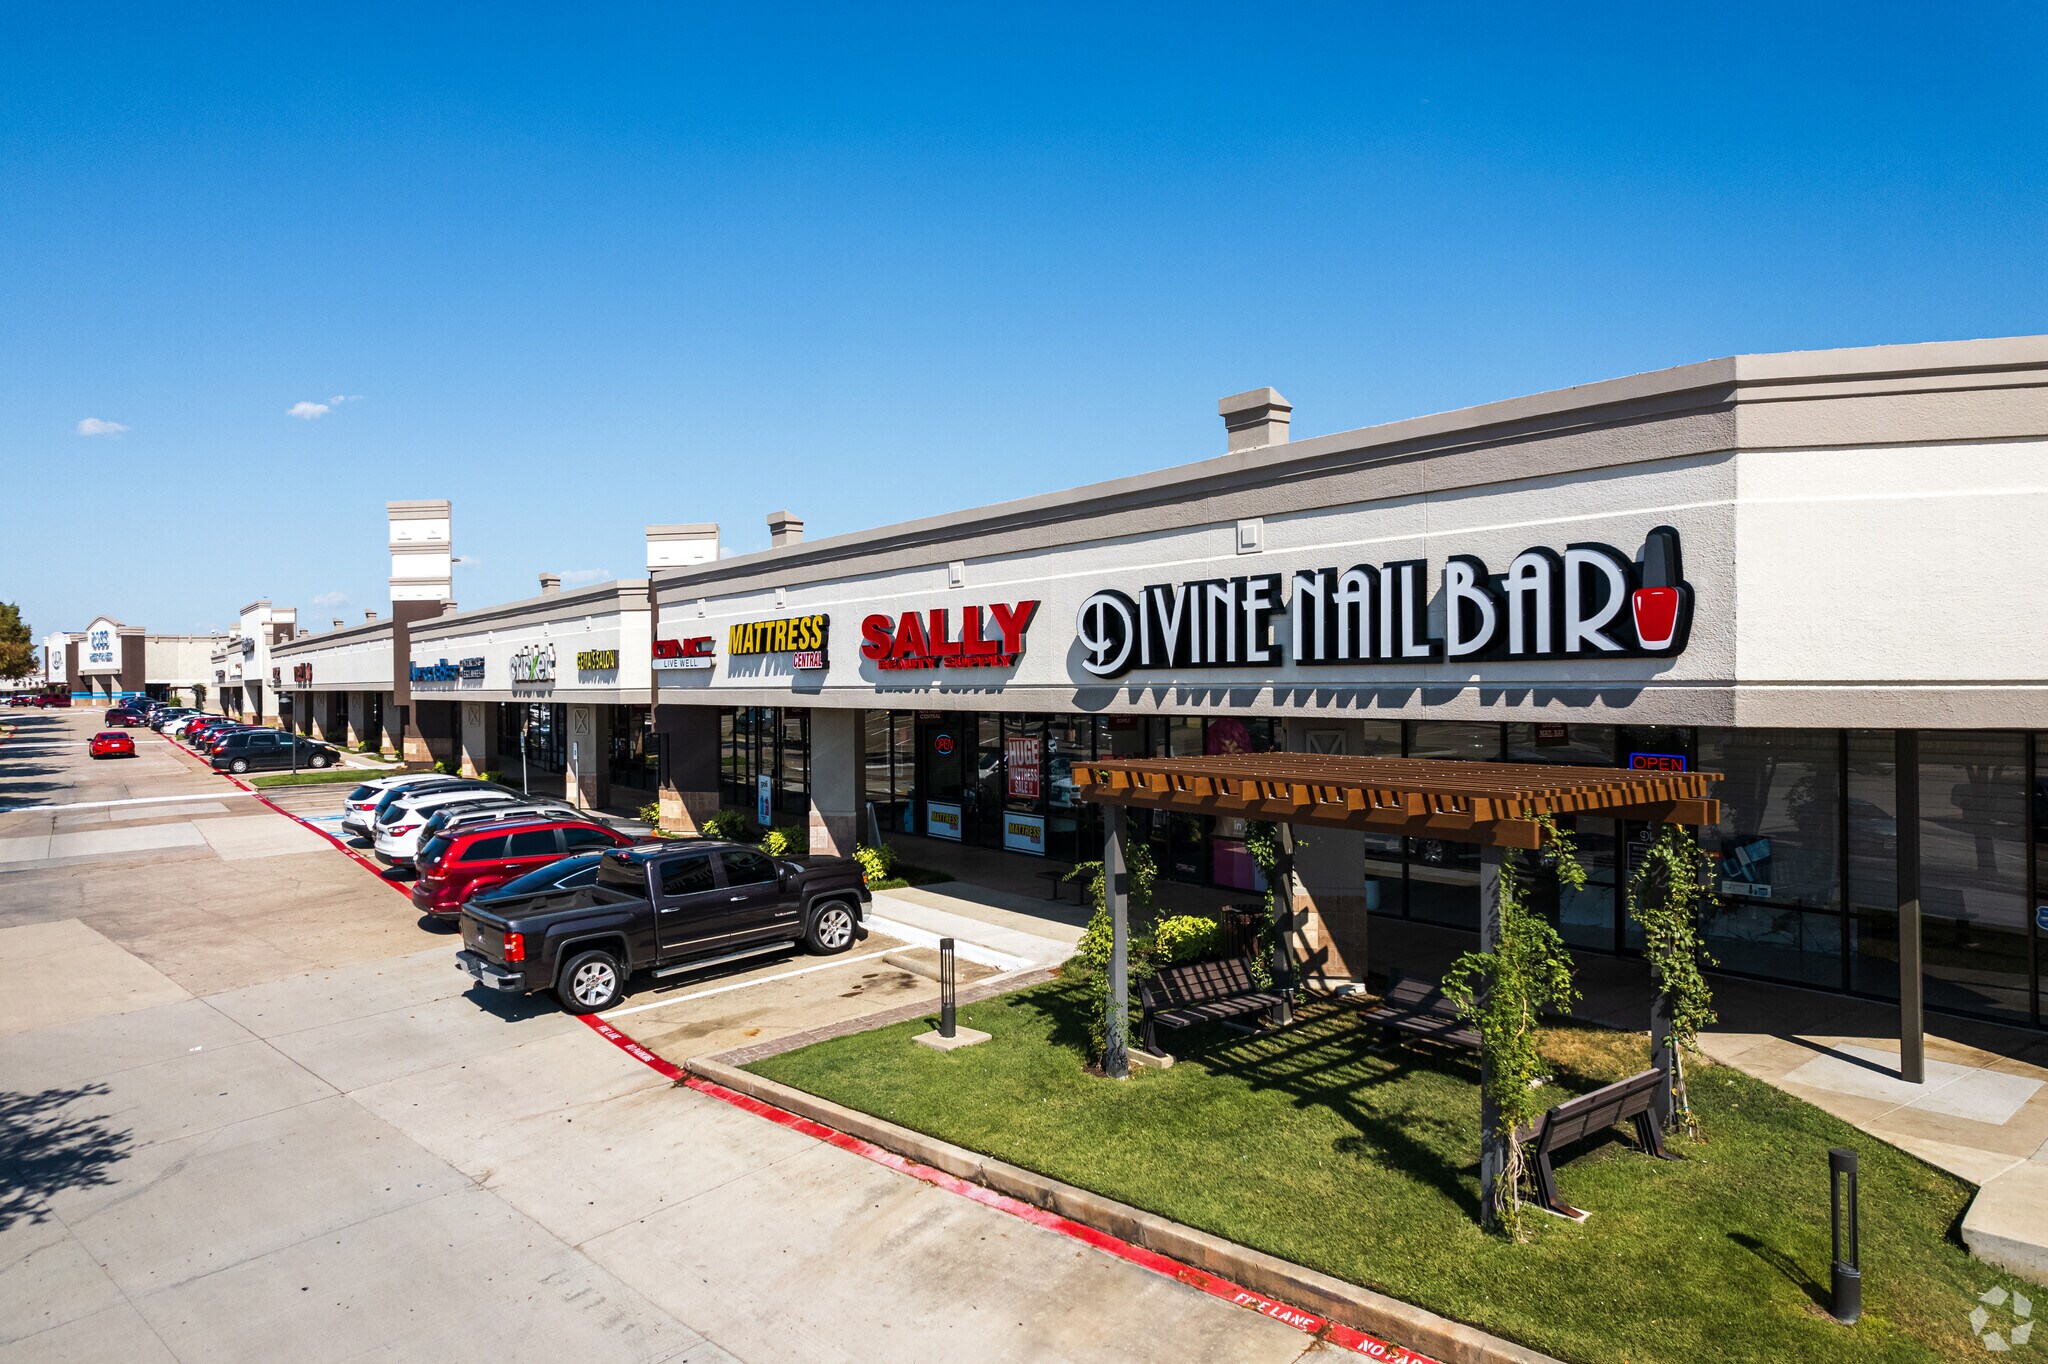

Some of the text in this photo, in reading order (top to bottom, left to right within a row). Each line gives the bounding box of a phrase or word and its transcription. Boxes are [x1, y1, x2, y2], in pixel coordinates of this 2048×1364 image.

[1076, 546, 1628, 676] DIVINE NAIL BAR
[728, 615, 829, 655] MATTRESS
[861, 600, 1041, 661] SALLY
[652, 636, 716, 658] GNC
[509, 643, 555, 683] cricket
[663, 659, 698, 668] LIVE WELL
[792, 651, 823, 668] CENTRAL
[878, 654, 1018, 671] BEAUTY SUPPLY
[934, 738, 954, 750] OPEN
[1009, 739, 1039, 766] HUGE
[1633, 755, 1683, 771] OPEN
[1010, 767, 1038, 782] MATTRESS
[1014, 780, 1027, 794] SALE
[931, 811, 959, 825] MATTRESS
[1008, 822, 1041, 838] MATTRESS
[1269, 1306, 1315, 1332] LANE
[1357, 1339, 1385, 1356] NO
